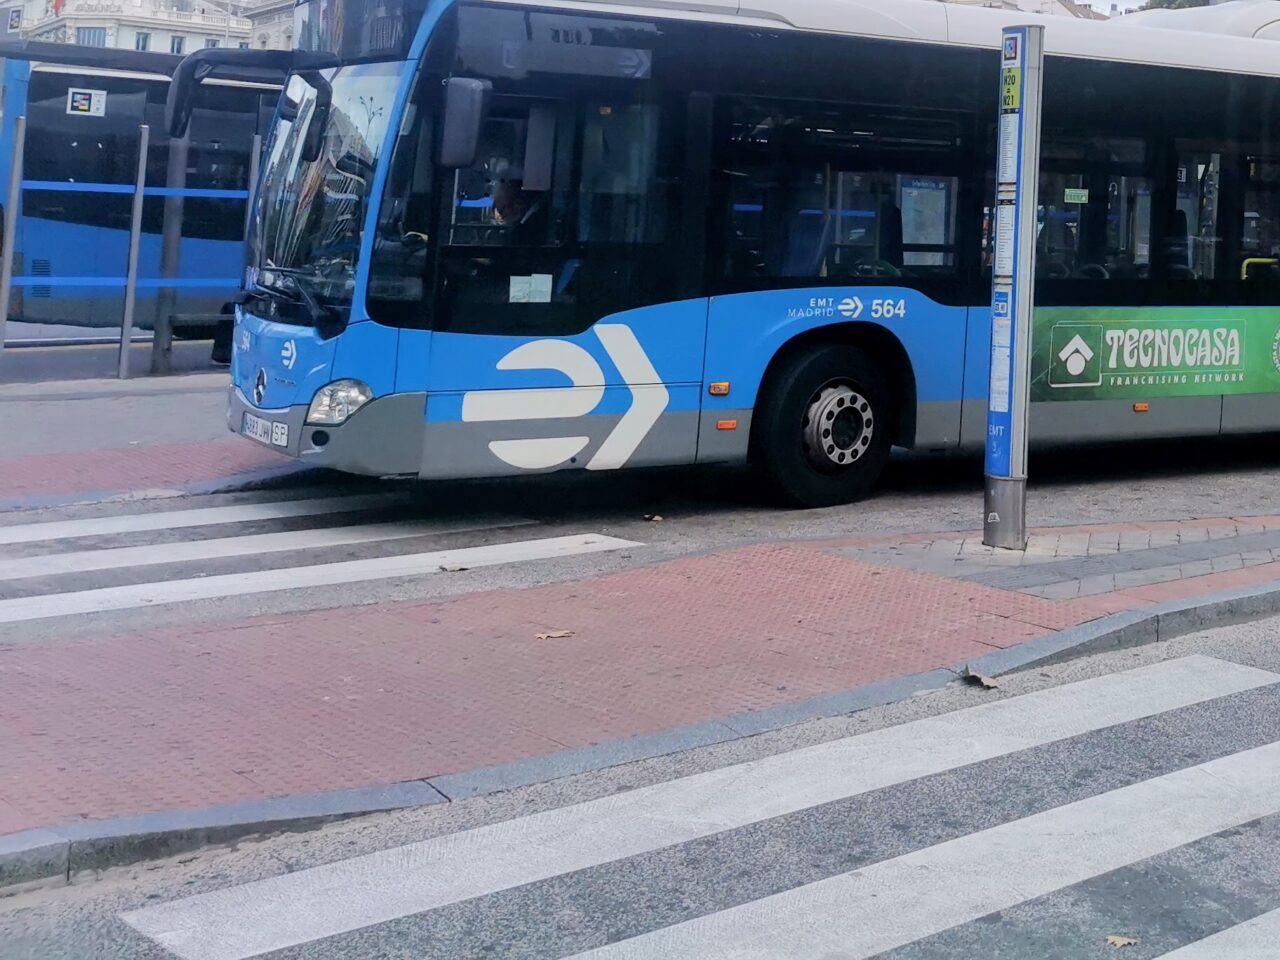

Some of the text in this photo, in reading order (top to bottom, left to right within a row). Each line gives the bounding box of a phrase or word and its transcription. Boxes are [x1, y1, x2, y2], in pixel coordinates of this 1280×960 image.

[809, 298, 834, 307] EMT
[870, 299, 906, 318] 564
[787, 308, 834, 317] MADRID
[1105, 328, 1241, 369] TECNOCASA
[1109, 372, 1245, 386] FRANCHISING NETWORK
[274, 425, 286, 443] SP
[989, 424, 1005, 436] EMT
